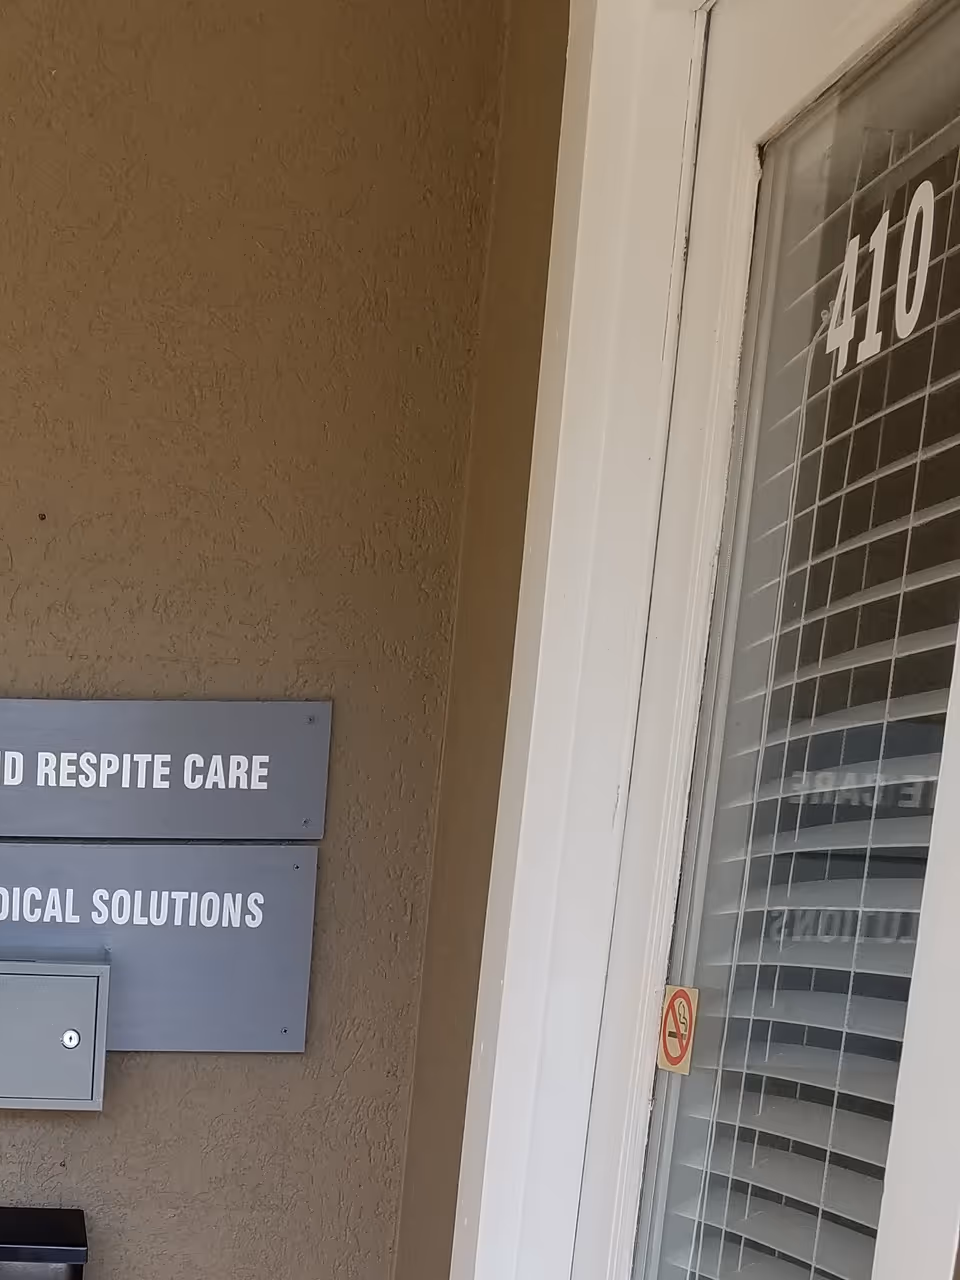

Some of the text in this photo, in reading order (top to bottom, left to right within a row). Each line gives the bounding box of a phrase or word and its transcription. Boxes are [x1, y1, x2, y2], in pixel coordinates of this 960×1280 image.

[825, 180, 935, 377] 410
[36, 751, 171, 790] RESPITE
[183, 753, 270, 791] CARE
[91, 888, 265, 928] SOLUTIONS
